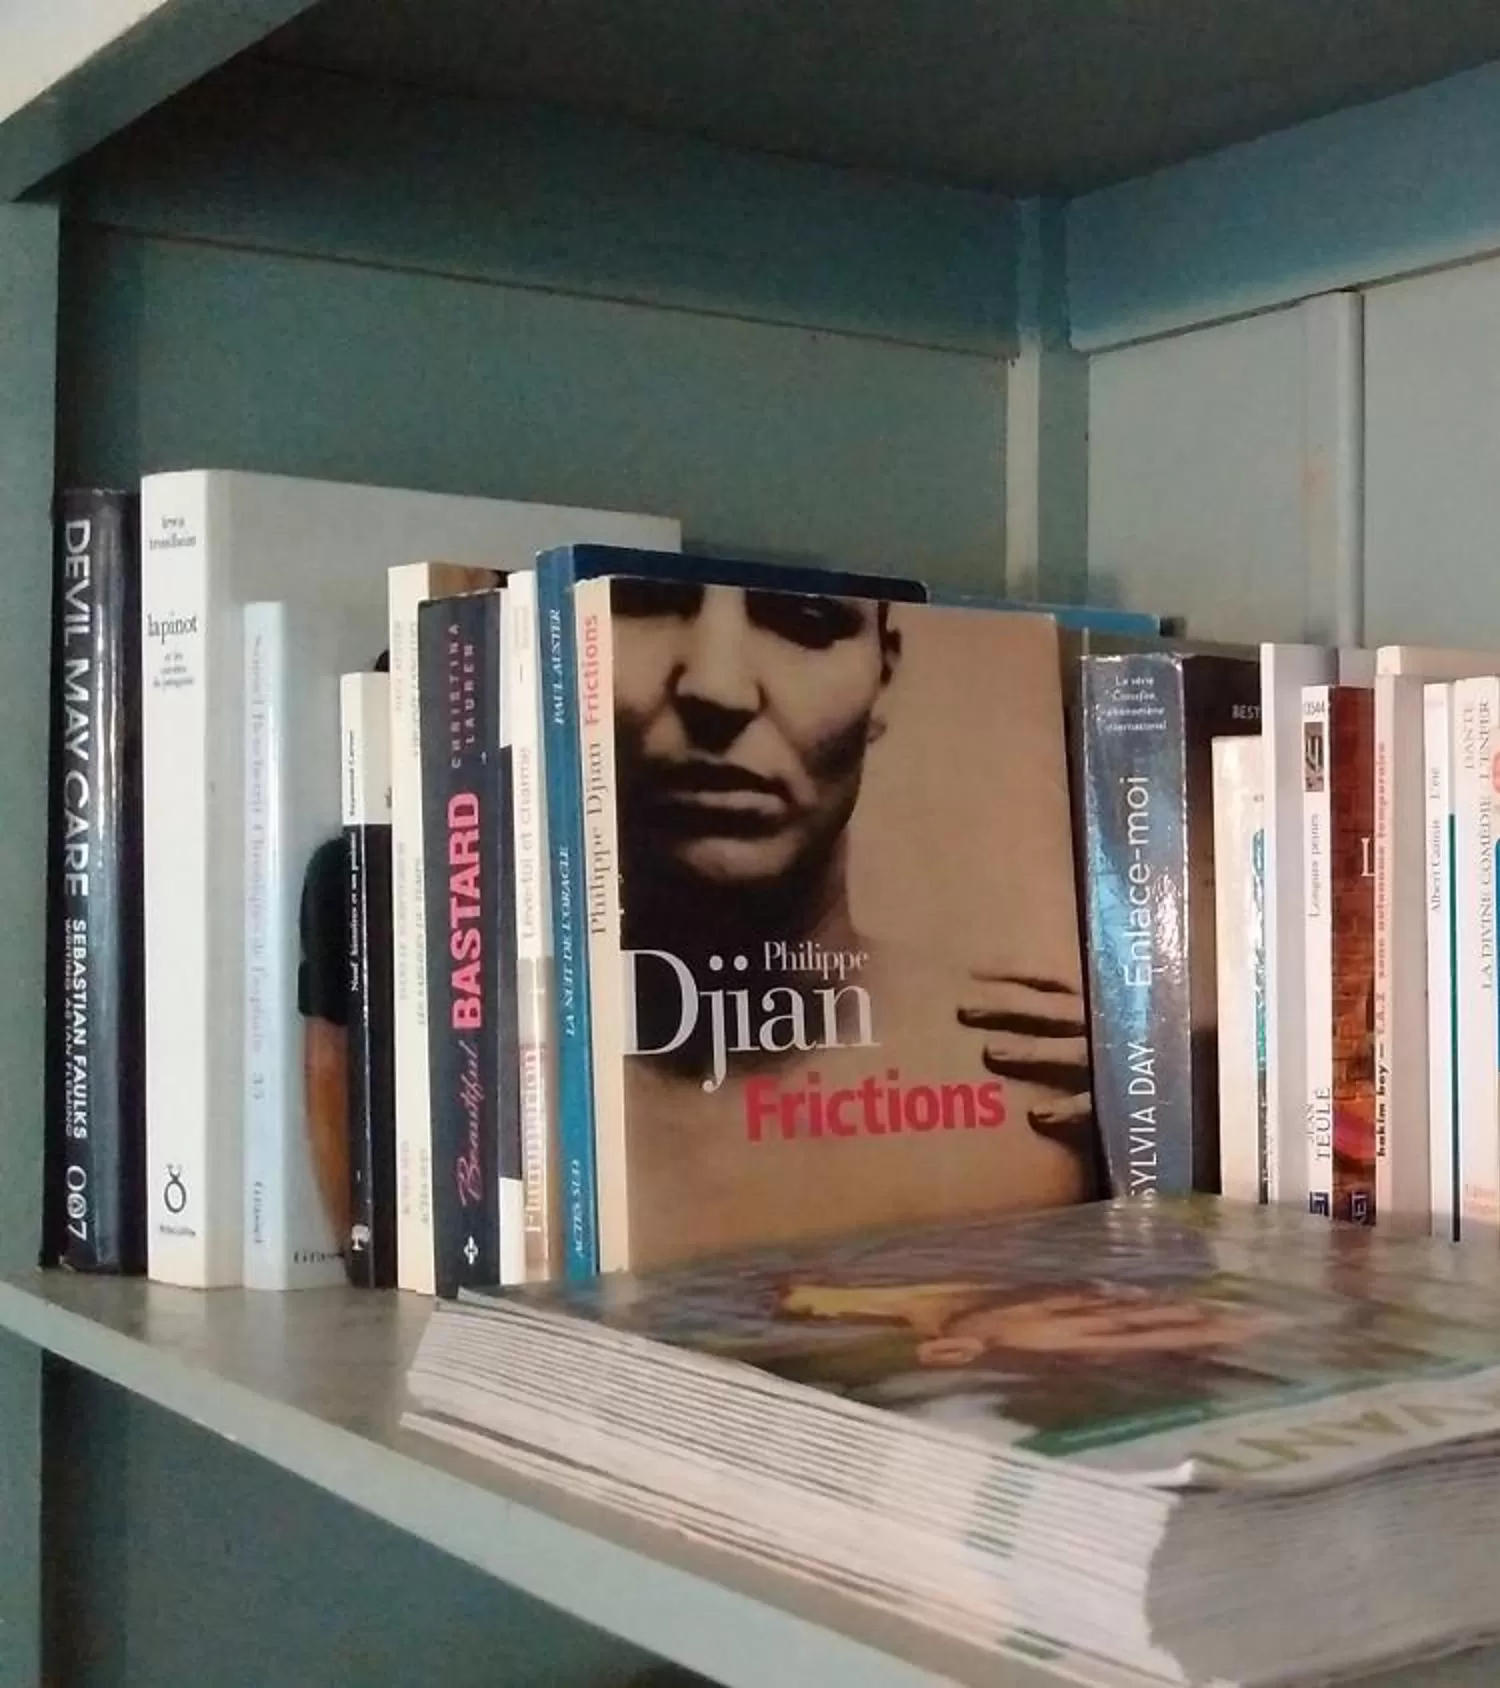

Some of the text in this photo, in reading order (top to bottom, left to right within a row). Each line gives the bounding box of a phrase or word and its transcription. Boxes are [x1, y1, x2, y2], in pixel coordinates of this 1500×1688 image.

[63, 519, 91, 647] DEVIL
[147, 612, 198, 646] lapinot
[63, 659, 90, 760] MAY
[446, 623, 462, 770] CHRISTINA
[463, 643, 476, 744] LAUREN
[584, 613, 600, 728] Frictions
[63, 770, 90, 898] CARE
[589, 827, 611, 936] Philippe
[1119, 775, 1154, 987] Enlace-moi
[72, 918, 88, 1046] SEBASTIAN
[446, 791, 485, 1207] Beautiful BASTARD
[764, 941, 870, 981] Philippe
[564, 1015, 575, 1037] LA
[623, 948, 880, 1093] Djian
[1127, 1041, 1156, 1096] DAY
[72, 1055, 88, 1140] FAULKS
[741, 1068, 1006, 1143] Frictions
[1376, 1064, 1389, 1096] bey
[1376, 1103, 1386, 1158] hakim
